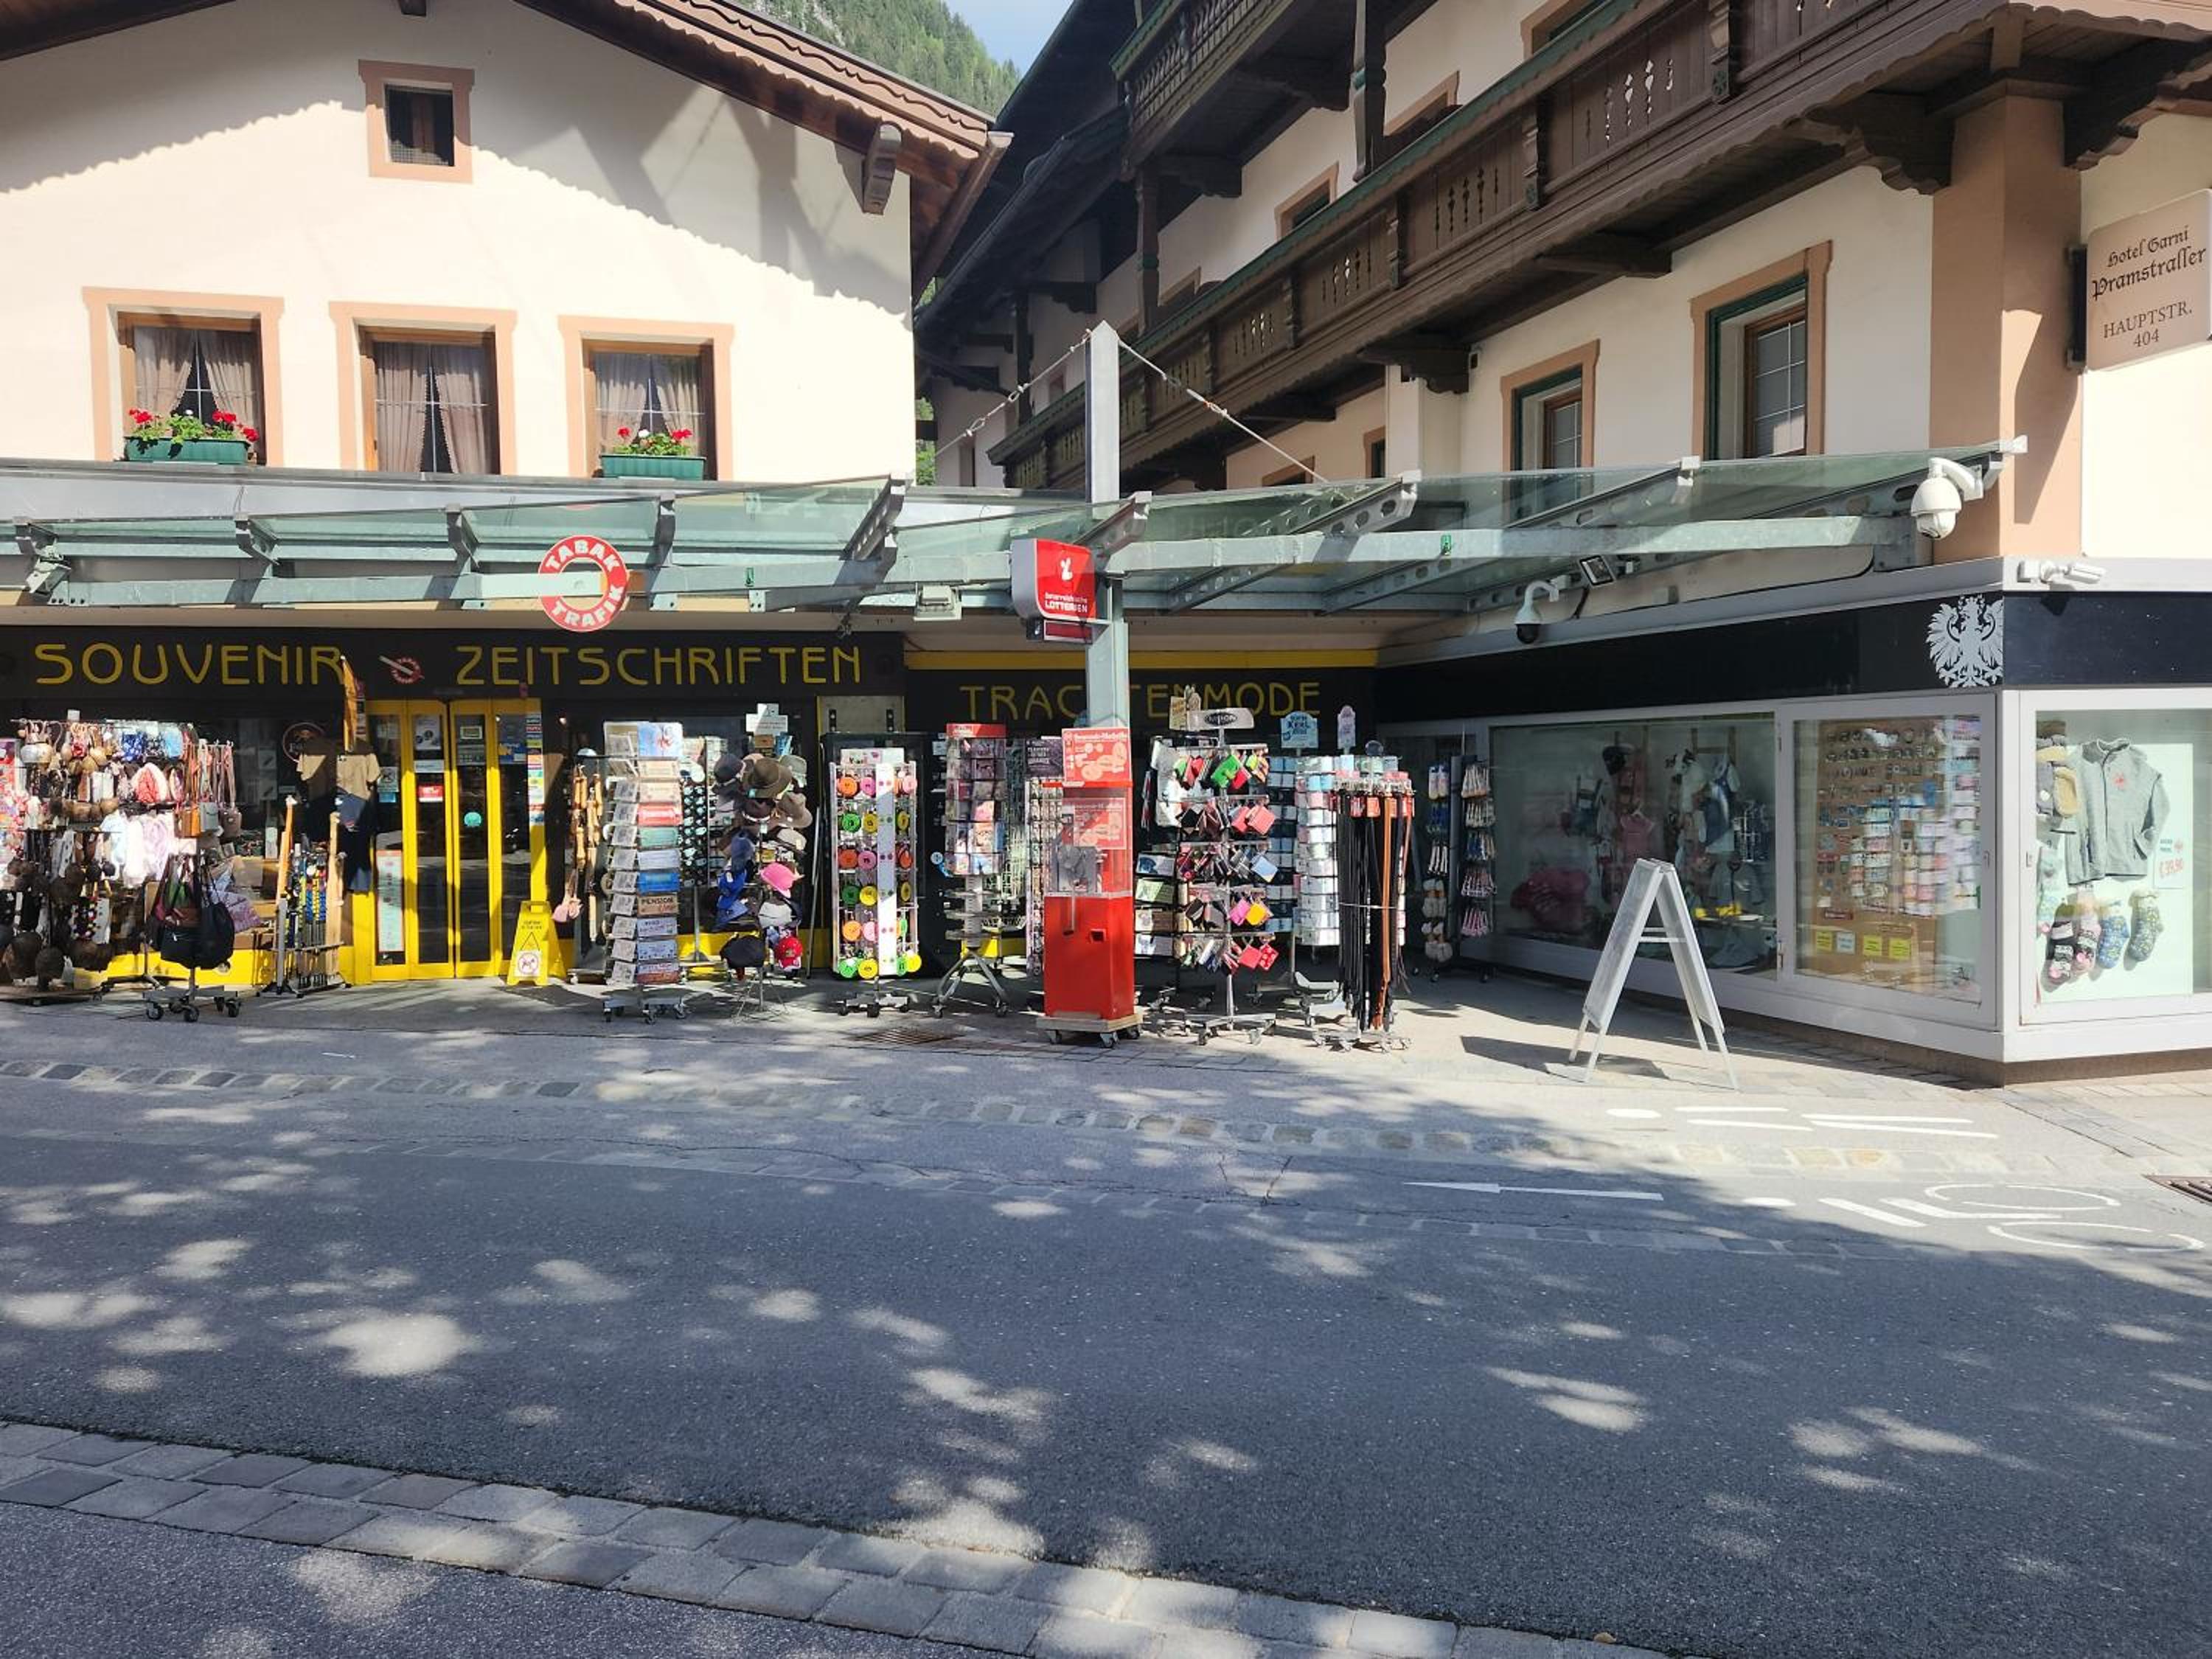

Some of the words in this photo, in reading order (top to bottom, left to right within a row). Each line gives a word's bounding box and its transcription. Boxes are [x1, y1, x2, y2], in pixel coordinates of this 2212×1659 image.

[2107, 238, 2146, 268] Hotel
[2147, 225, 2189, 253] Garni
[2103, 300, 2193, 339] HAUPTSTR.
[2133, 329, 2160, 347] 404
[545, 540, 620, 572] TABAK
[35, 642, 344, 685] SOUVENIR
[456, 646, 861, 685] ZEITSCHRIFTEN
[959, 681, 1321, 720] TRACEMODE
